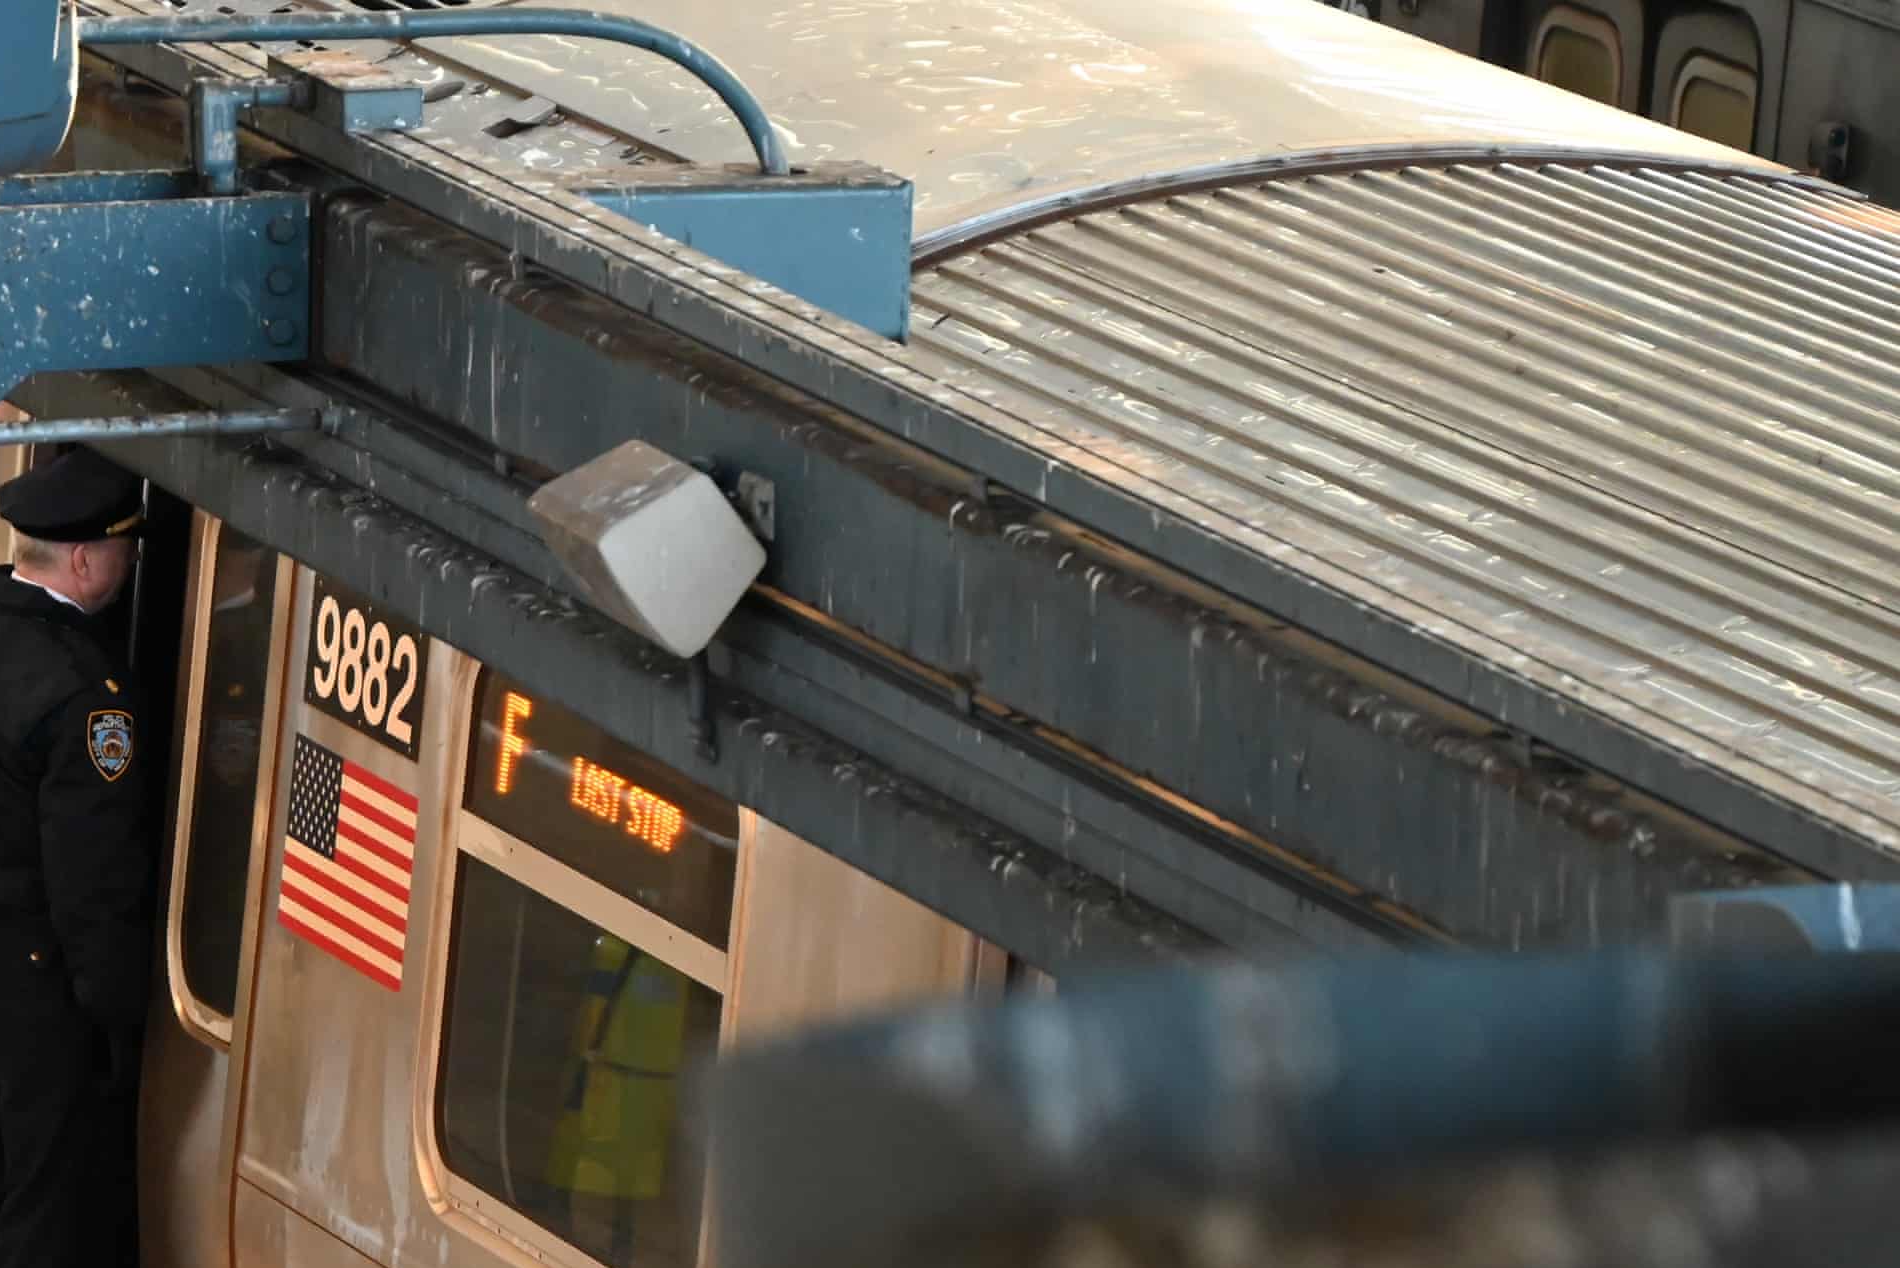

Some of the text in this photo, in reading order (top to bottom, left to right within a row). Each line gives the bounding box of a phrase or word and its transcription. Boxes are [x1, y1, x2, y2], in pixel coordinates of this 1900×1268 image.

[313, 595, 419, 745] 9882
[496, 690, 534, 794] F
[570, 756, 684, 853] LAST STOP
